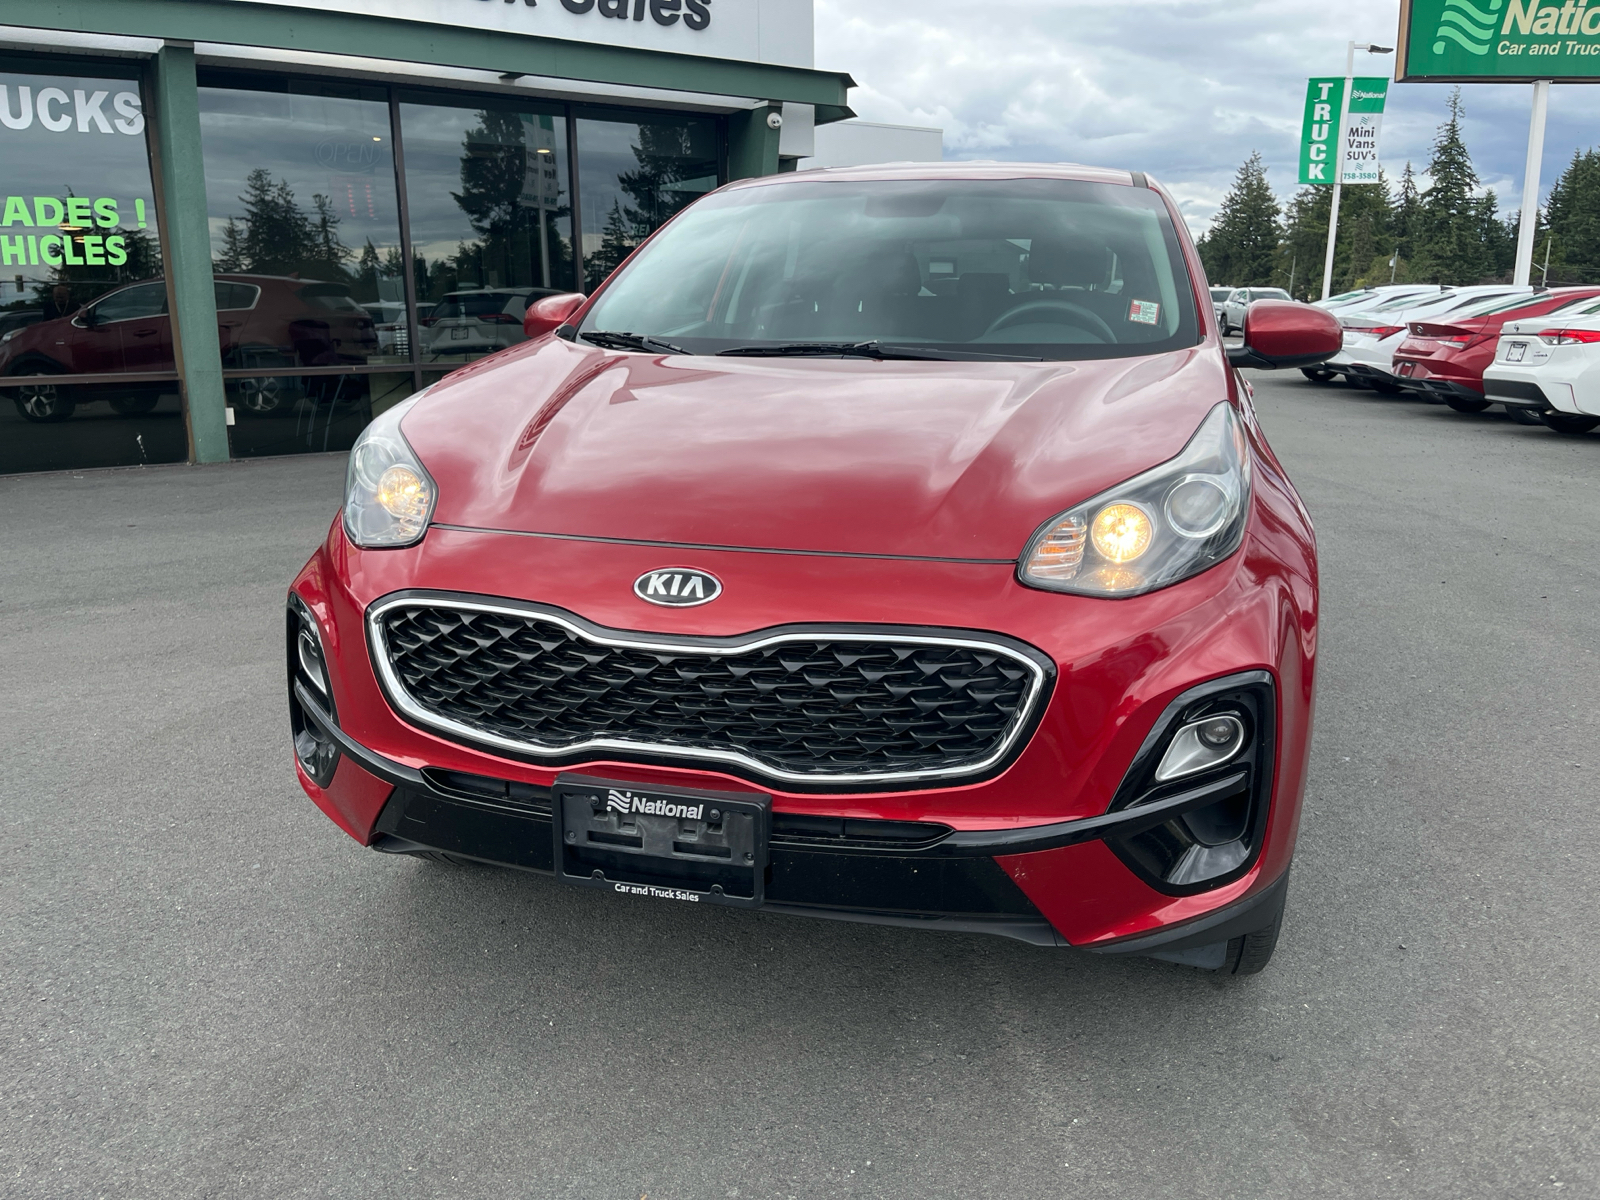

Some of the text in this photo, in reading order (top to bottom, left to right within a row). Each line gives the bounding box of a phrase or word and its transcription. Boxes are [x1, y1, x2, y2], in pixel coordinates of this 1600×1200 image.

[1497, 41, 1526, 56] Car
[1529, 41, 1561, 56] and
[1359, 91, 1386, 99] National
[0, 84, 145, 135] UCKS
[1308, 82, 1334, 180] TRUCK
[1348, 126, 1375, 138] Mini
[319, 142, 374, 164] OPEN
[1347, 138, 1375, 149] Vans
[1346, 150, 1376, 160] SUV's
[1343, 172, 1377, 180] 758-3580
[0, 196, 120, 228] ADES
[0, 234, 127, 266] HICLES
[646, 573, 704, 598] KIA
[631, 796, 704, 820] National
[614, 883, 699, 902] Car and Truck Sales
